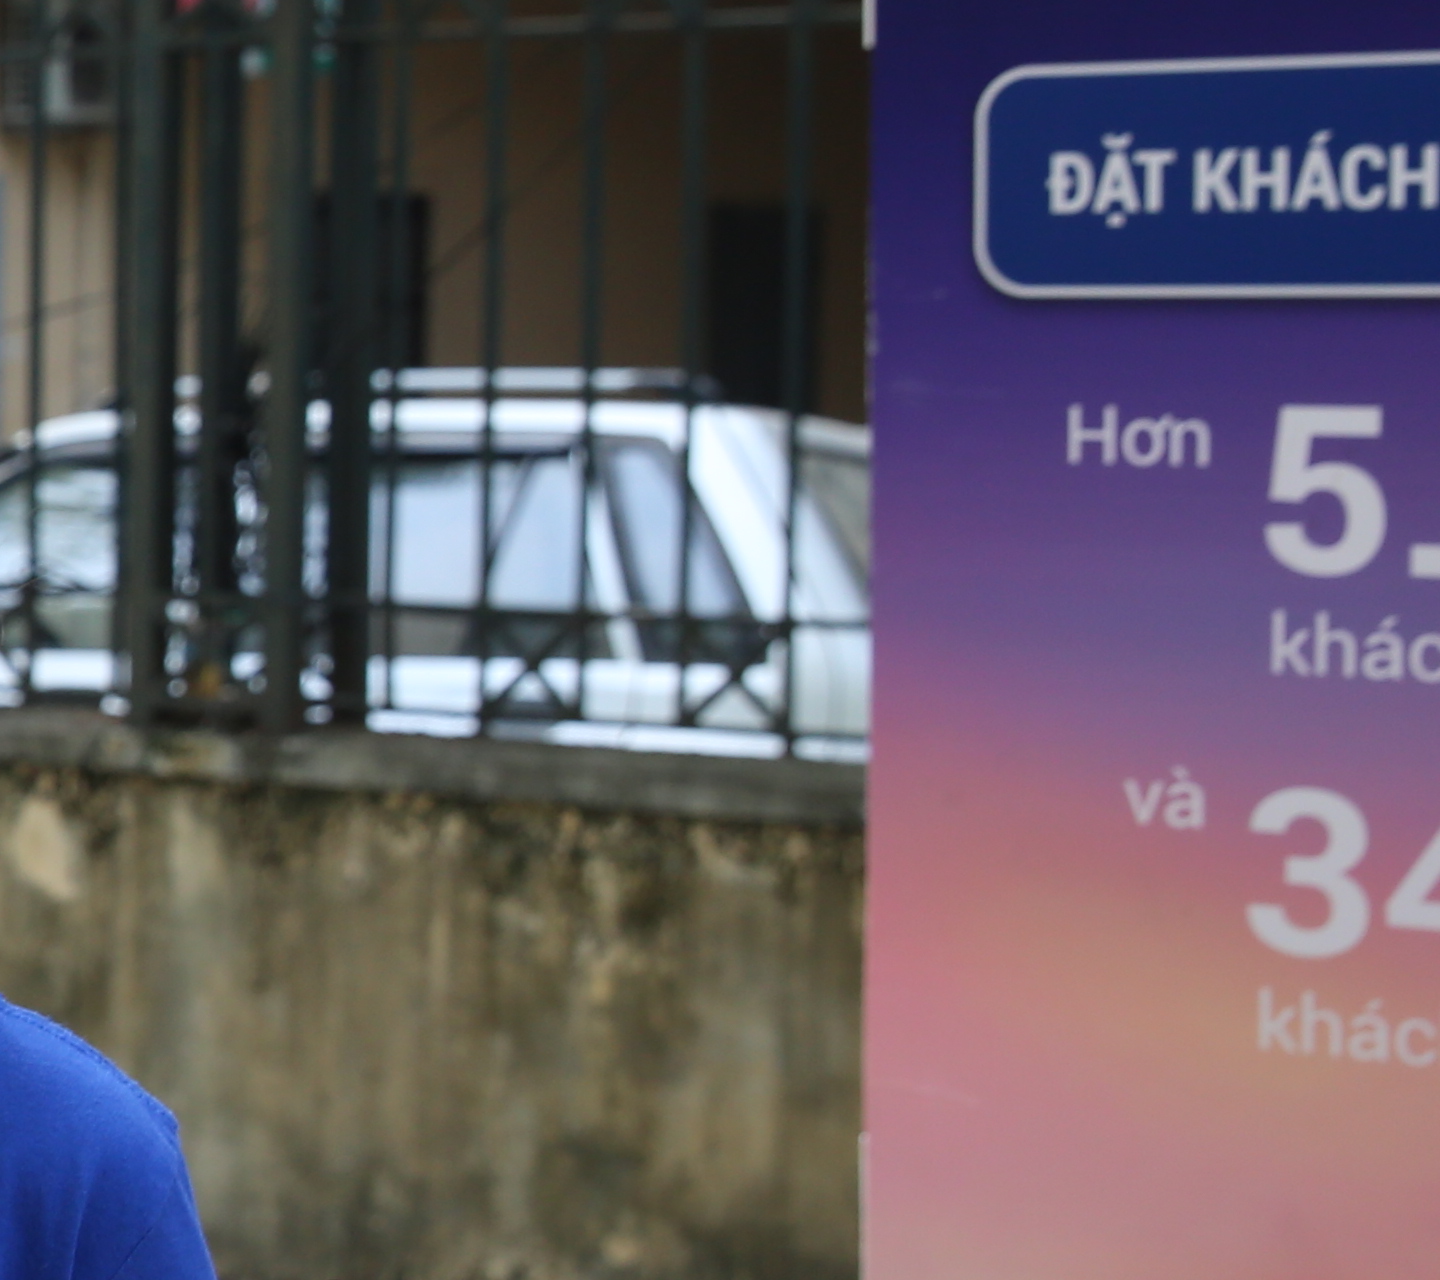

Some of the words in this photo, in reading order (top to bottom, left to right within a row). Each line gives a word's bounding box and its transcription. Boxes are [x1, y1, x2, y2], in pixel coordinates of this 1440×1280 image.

[1046, 131, 1177, 230] ĐẶT
[1192, 129, 1440, 214] KHÁCH
[1066, 404, 1212, 468] Hơn
[1123, 767, 1206, 831] và
